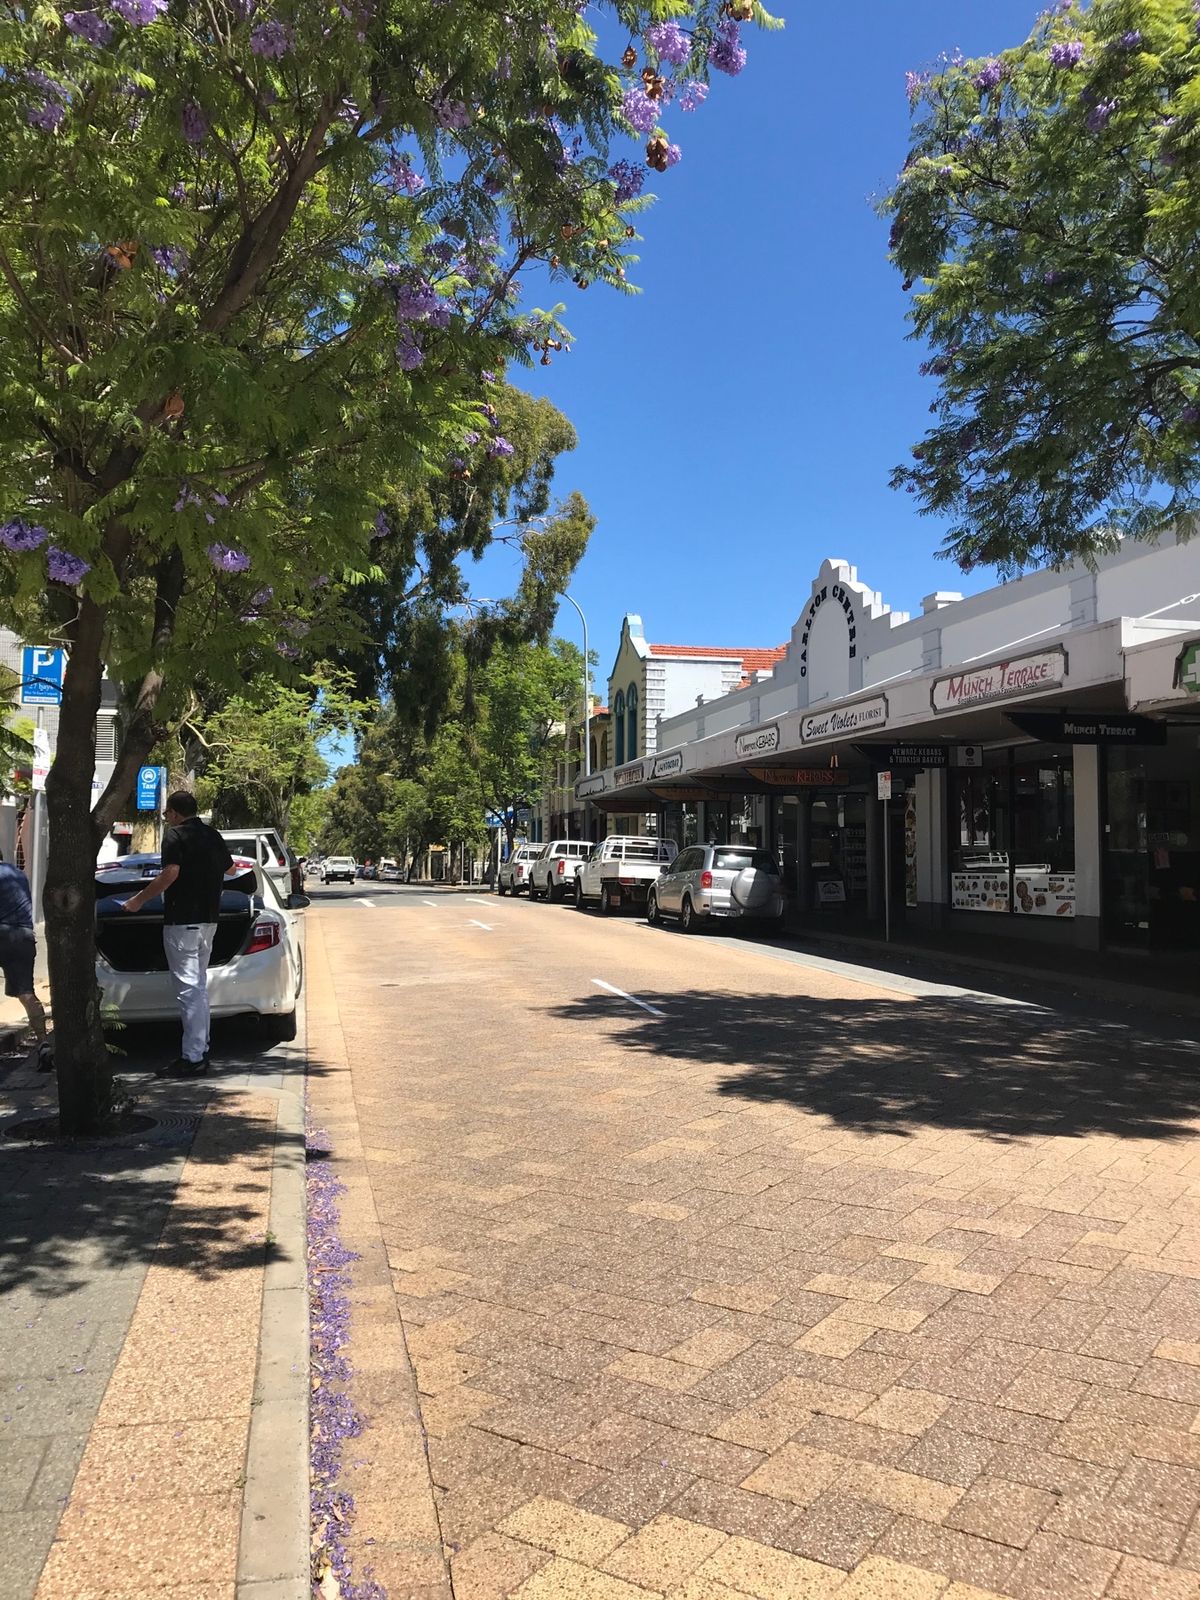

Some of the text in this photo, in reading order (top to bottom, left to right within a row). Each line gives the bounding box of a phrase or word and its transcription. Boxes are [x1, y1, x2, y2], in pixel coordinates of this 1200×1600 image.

[801, 585, 856, 677] CARLTON CENTRE
[32, 650, 55, 675] P
[947, 662, 1048, 700] MUNCH TERRACE
[806, 707, 883, 738] Sweet Violets FLORIST
[1063, 722, 1137, 736] MUNCH TERRACE
[892, 748, 942, 756] NEWROZ KEBABS
[895, 755, 921, 764] TURKISH
[922, 756, 945, 764] BAKERY
